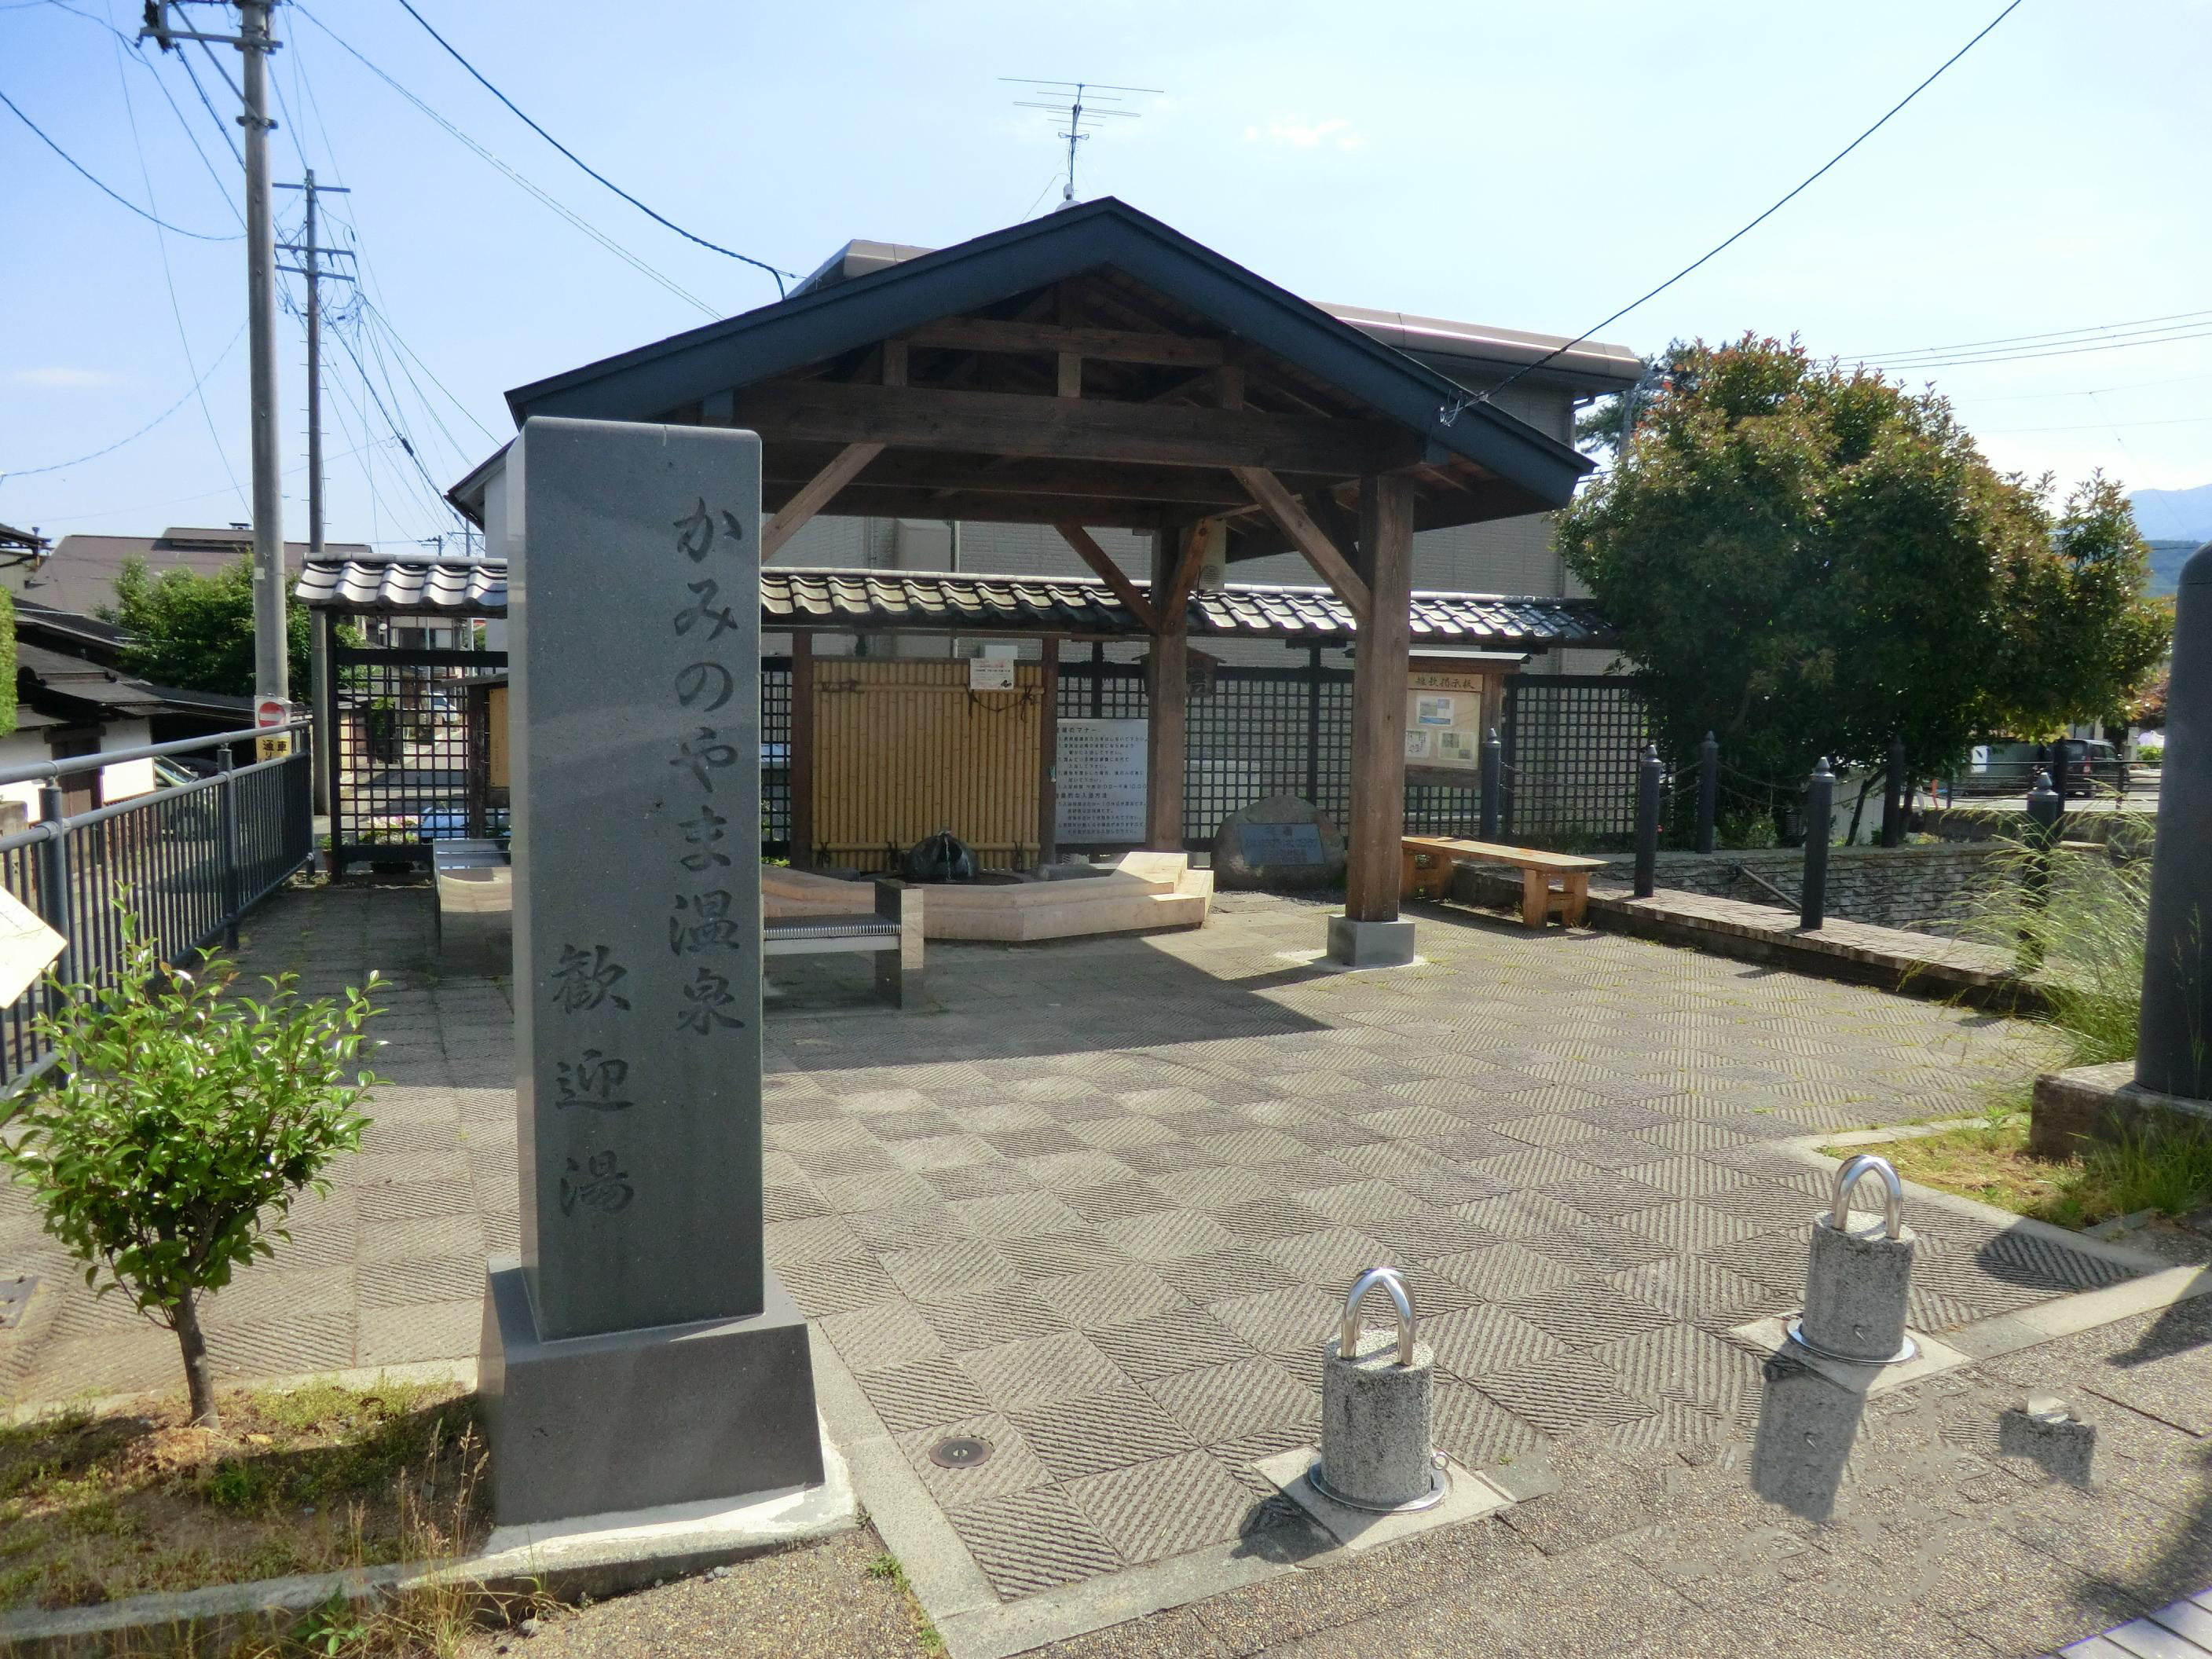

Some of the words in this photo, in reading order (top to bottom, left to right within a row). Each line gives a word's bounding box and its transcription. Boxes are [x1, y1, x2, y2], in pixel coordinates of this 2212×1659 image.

[669, 496, 745, 1036] かみのやま温泉
[551, 944, 635, 1218] 歓迎湯
